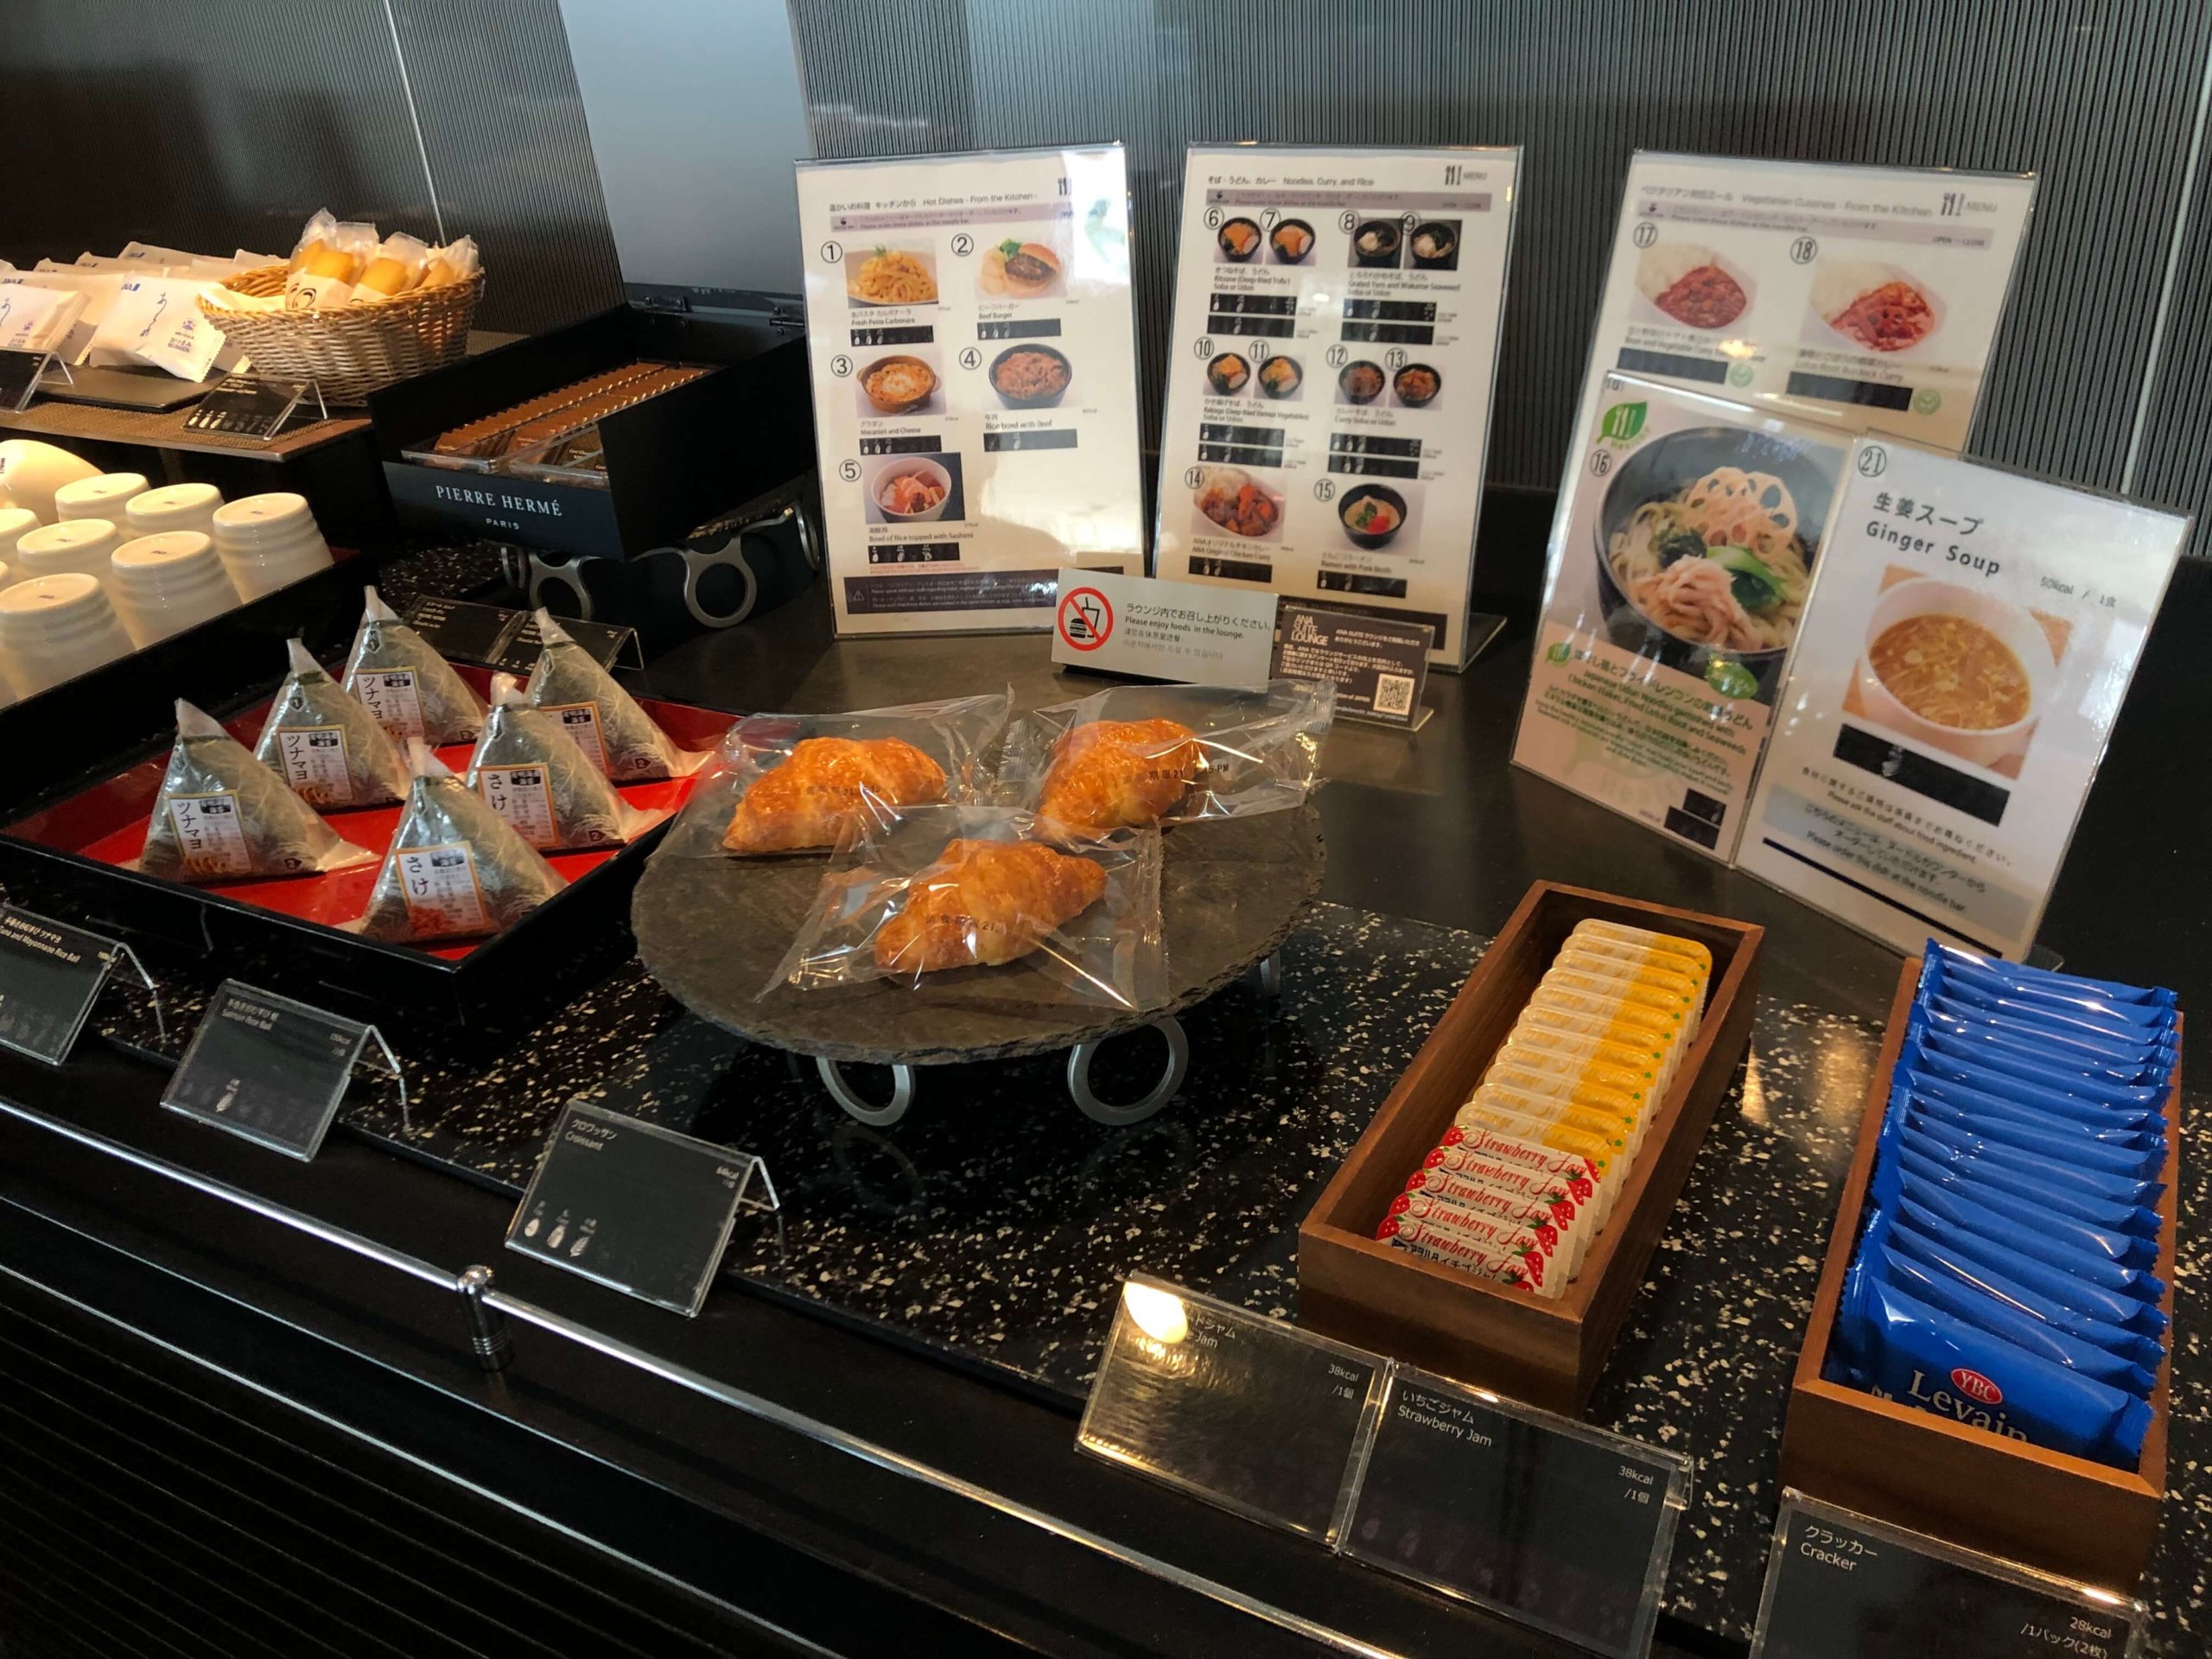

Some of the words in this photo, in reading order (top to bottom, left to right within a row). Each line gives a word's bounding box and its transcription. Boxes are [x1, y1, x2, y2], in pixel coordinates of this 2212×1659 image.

[923, 197, 936, 207] Hot
[938, 196, 963, 206] Dishes
[970, 194, 988, 203] From
[991, 194, 1002, 202] the
[1004, 193, 1033, 201] Kitchen
[985, 421, 1000, 430] Rice
[1001, 420, 1018, 429] bowl
[1020, 419, 1035, 429] with
[1037, 418, 1052, 428] Beef
[435, 485, 496, 507] PIERRE
[501, 495, 563, 517] HERMÉ
[1872, 491, 1985, 536] 生姜スープ
[486, 517, 520, 531] PARIS
[908, 533, 931, 542] topped
[949, 531, 974, 539] Sashimi
[1866, 520, 1936, 555] Ginger
[1945, 544, 2001, 577] Soup
[1125, 615, 1148, 626] Please
[1149, 620, 1170, 631] enjoy
[1171, 621, 1192, 632] foods
[1217, 628, 1244, 640] lounge.
[1294, 622, 1318, 634] SUITE
[1296, 614, 1313, 626] ANA
[1291, 631, 1328, 646] LOUNGE
[363, 676, 383, 720] ツナマヨ
[286, 734, 308, 780] ツナマヨ
[487, 773, 508, 811] さけ
[176, 802, 201, 849] ツナマヨ
[406, 856, 429, 896] さけ
[1807, 830, 1831, 849] Please
[1902, 874, 1916, 890] the
[1916, 883, 1948, 905] noodle
[564, 1131, 604, 1151] Croissant
[571, 1118, 618, 1140] クロワッサン
[1462, 1128, 1548, 1167] Strawberry
[1443, 1150, 1530, 1192] Strawberry
[1426, 1172, 1513, 1217] Strawberry
[1410, 1197, 1497, 1243] Strawberry
[1397, 1221, 1488, 1266] Strawberry
[1195, 1332, 1218, 1349] Jam
[1327, 1363, 1359, 1382] 38kcal
[1961, 1371, 1995, 1402] YBC
[1331, 1385, 1355, 1400] /1個
[1402, 1389, 1474, 1425] いちごジャム
[1397, 1405, 1465, 1439] Strawberry
[1465, 1429, 1492, 1448] Jam
[1618, 1465, 1654, 1486] 38kcal
[1624, 1488, 1649, 1505] /1個
[1800, 1541, 1858, 1573] Cracker
[1804, 1523, 1878, 1559] クラッカー
[2069, 1617, 2112, 1639] 28kcal
